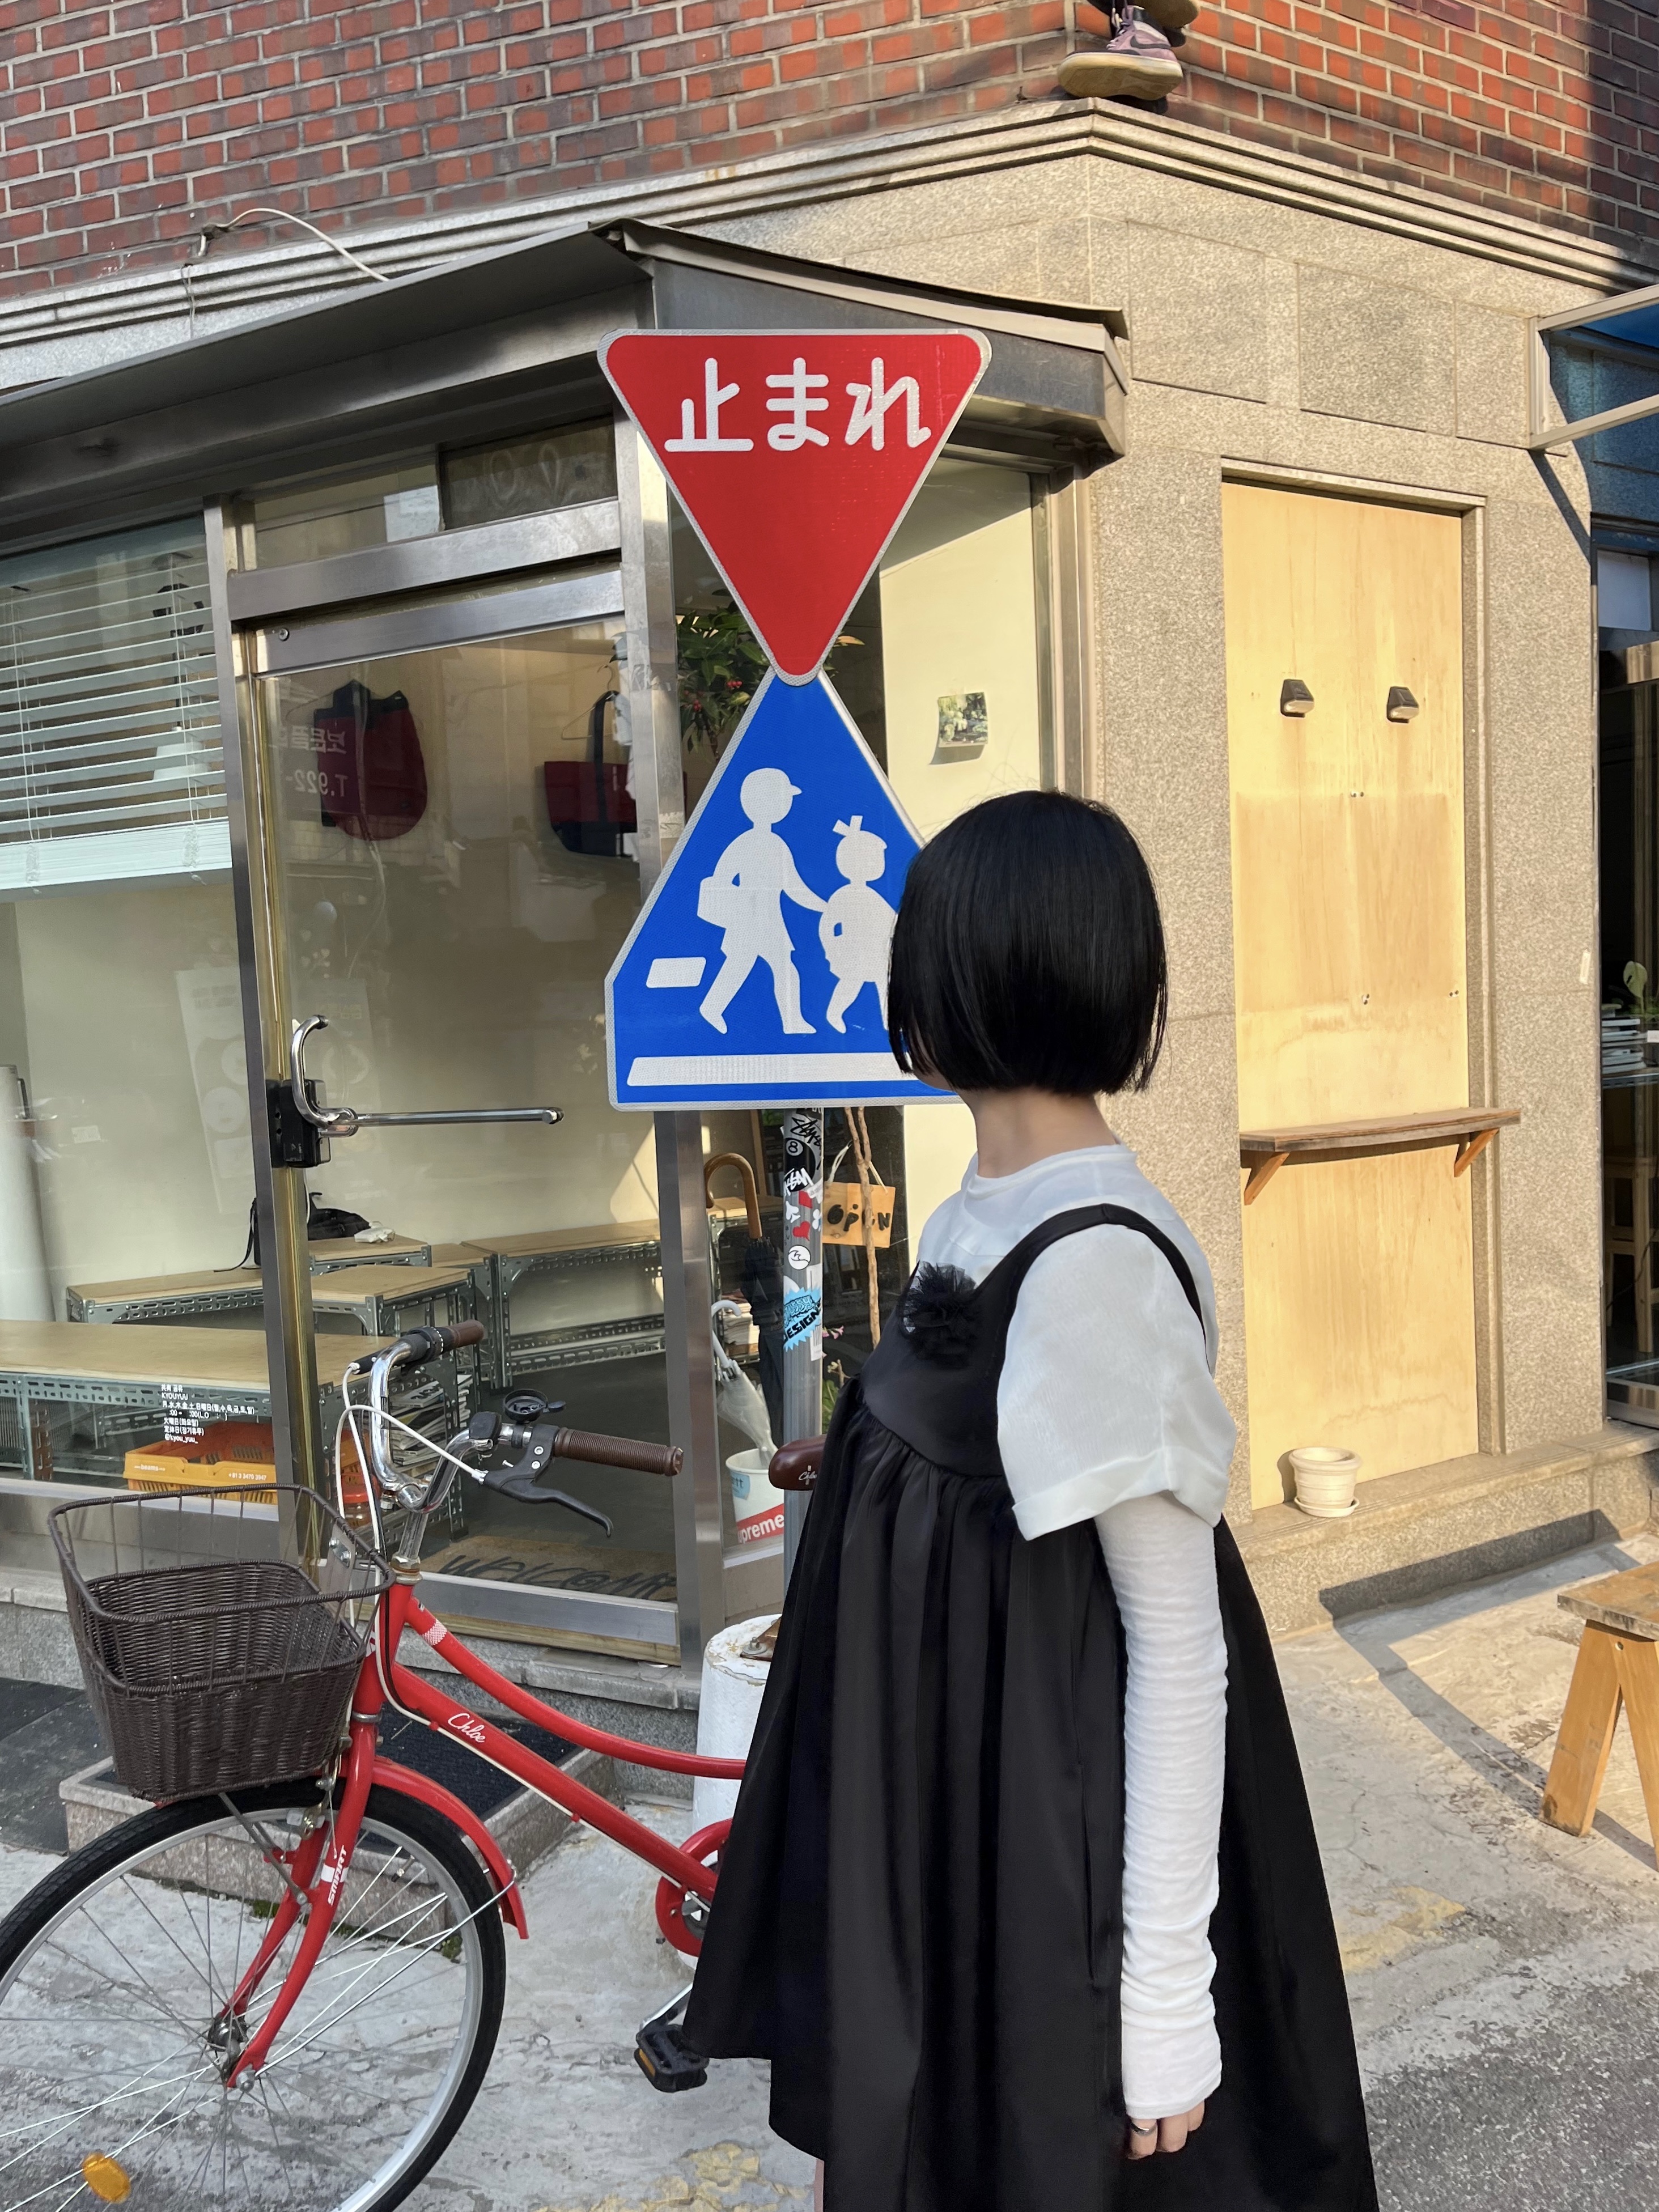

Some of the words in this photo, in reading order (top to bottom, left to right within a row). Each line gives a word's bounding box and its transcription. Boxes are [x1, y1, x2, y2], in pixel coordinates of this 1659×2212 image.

[664, 357, 931, 452] 止まれ
[788, 1141, 798, 1153] 8
[448, 1713, 486, 1743] Chloe
[328, 1845, 346, 1906] SMART
